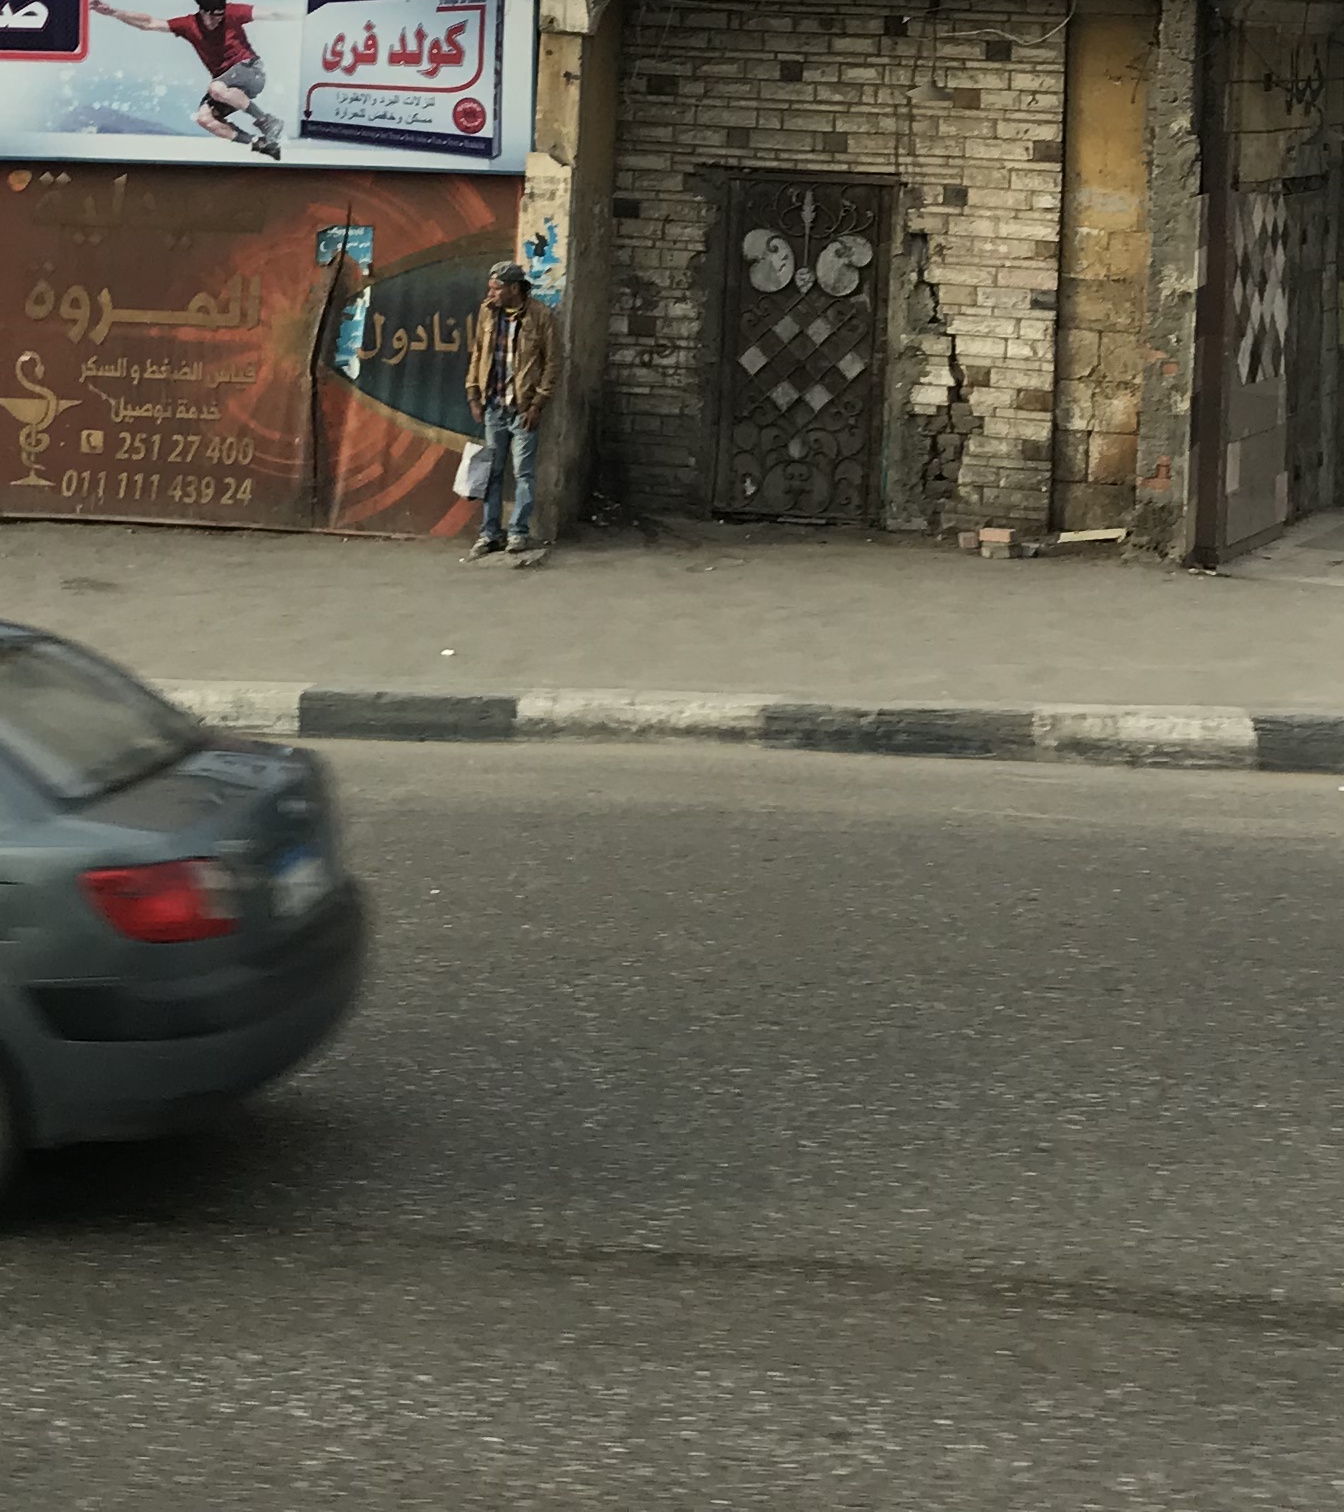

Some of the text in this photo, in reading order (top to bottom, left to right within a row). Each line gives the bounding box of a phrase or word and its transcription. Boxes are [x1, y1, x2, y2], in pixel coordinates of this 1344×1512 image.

[322, 19, 468, 79] كولد فرى
[24, 259, 261, 345] المروة
[110, 396, 222, 424] خدمة توصيل
[115, 431, 255, 465] 251 27 400
[61, 470, 253, 506] 011 111 439 24
